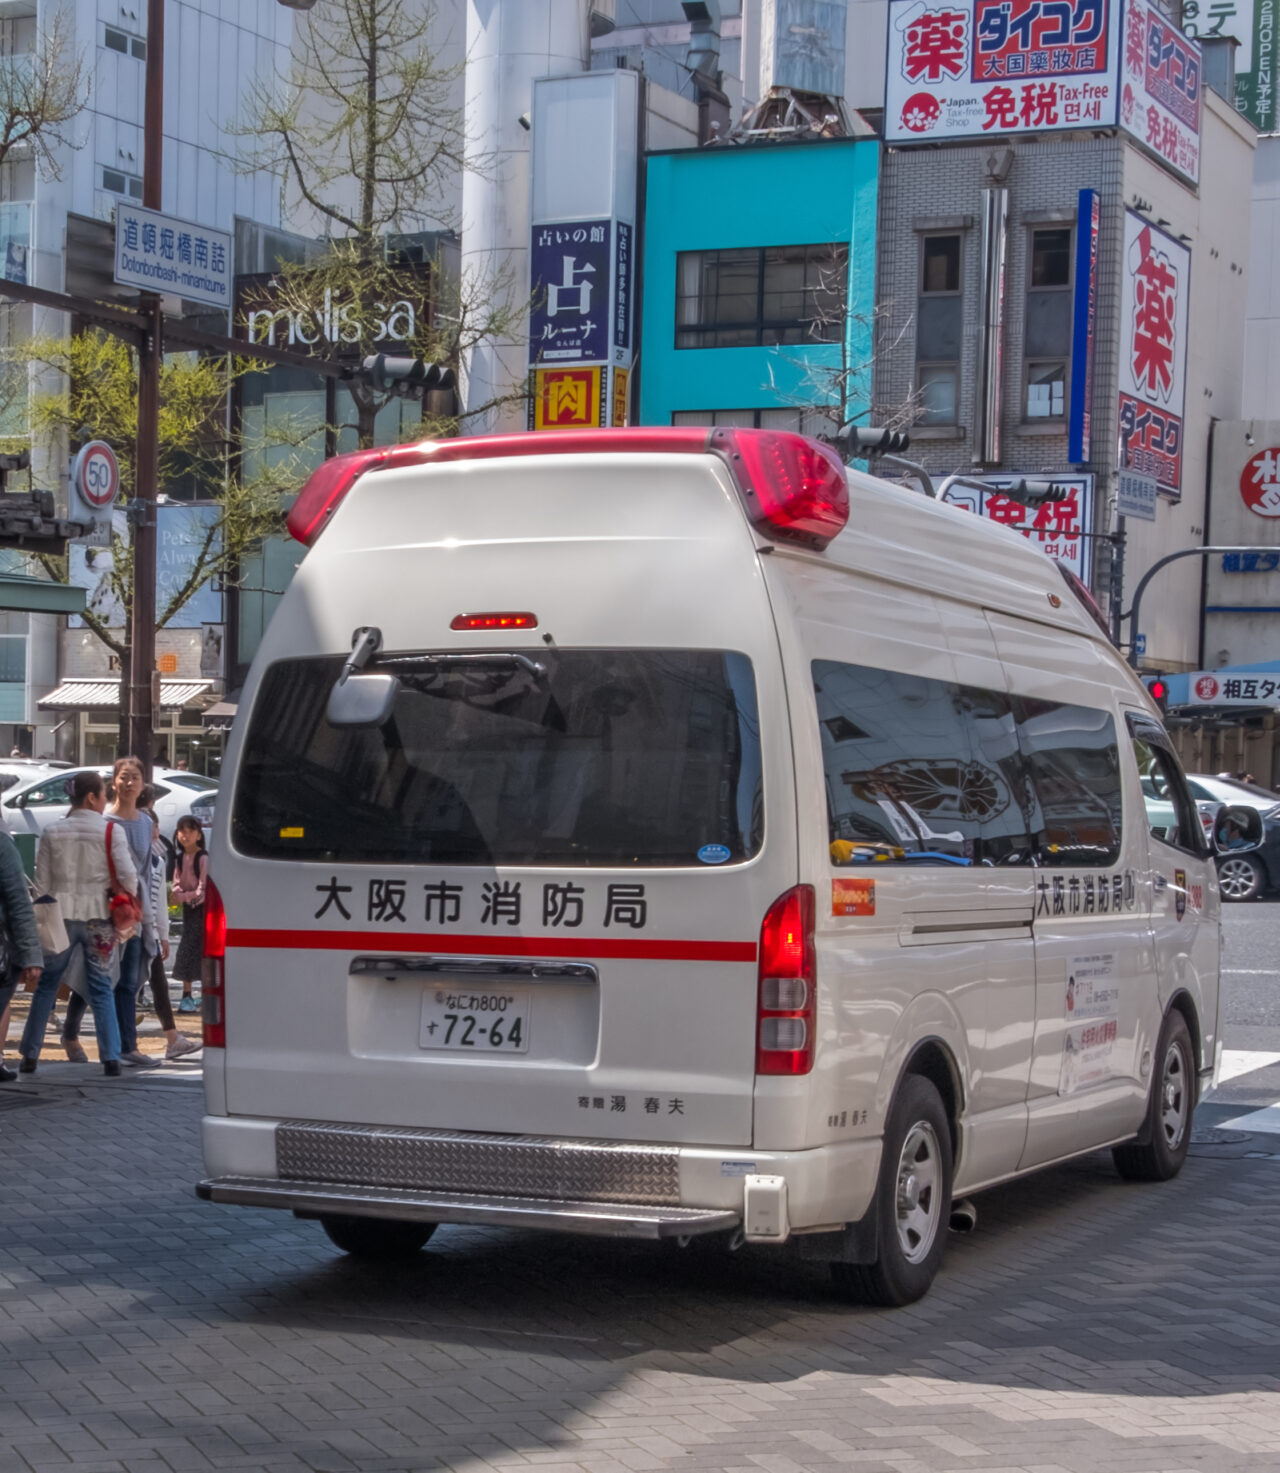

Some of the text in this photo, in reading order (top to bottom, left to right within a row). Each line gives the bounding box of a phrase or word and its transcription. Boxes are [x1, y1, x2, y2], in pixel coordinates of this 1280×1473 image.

[906, 12, 966, 80] 薬
[978, 0, 1104, 52] ダイコク
[947, 108, 984, 117] Tax-free
[982, 82, 1060, 131] 免税
[1059, 84, 1109, 101] Tax-Free
[1063, 101, 1101, 123] 면세
[946, 118, 969, 128] Shop
[1146, 105, 1178, 164] 免税
[123, 217, 225, 274] 道頓堀橋南詰
[539, 225, 605, 247] 占いの館
[122, 253, 226, 295] Dotonboribashi-minamizume
[546, 256, 597, 317] 占
[541, 320, 597, 341] ルーナ
[1132, 226, 1177, 392] 薬
[547, 375, 587, 422] 肉
[1120, 401, 1179, 456] ダイコク
[88, 462, 109, 488] 50
[1222, 679, 1280, 699] 相互タ
[314, 876, 648, 929] 大阪市消防局
[443, 1014, 523, 1048] 72-64
